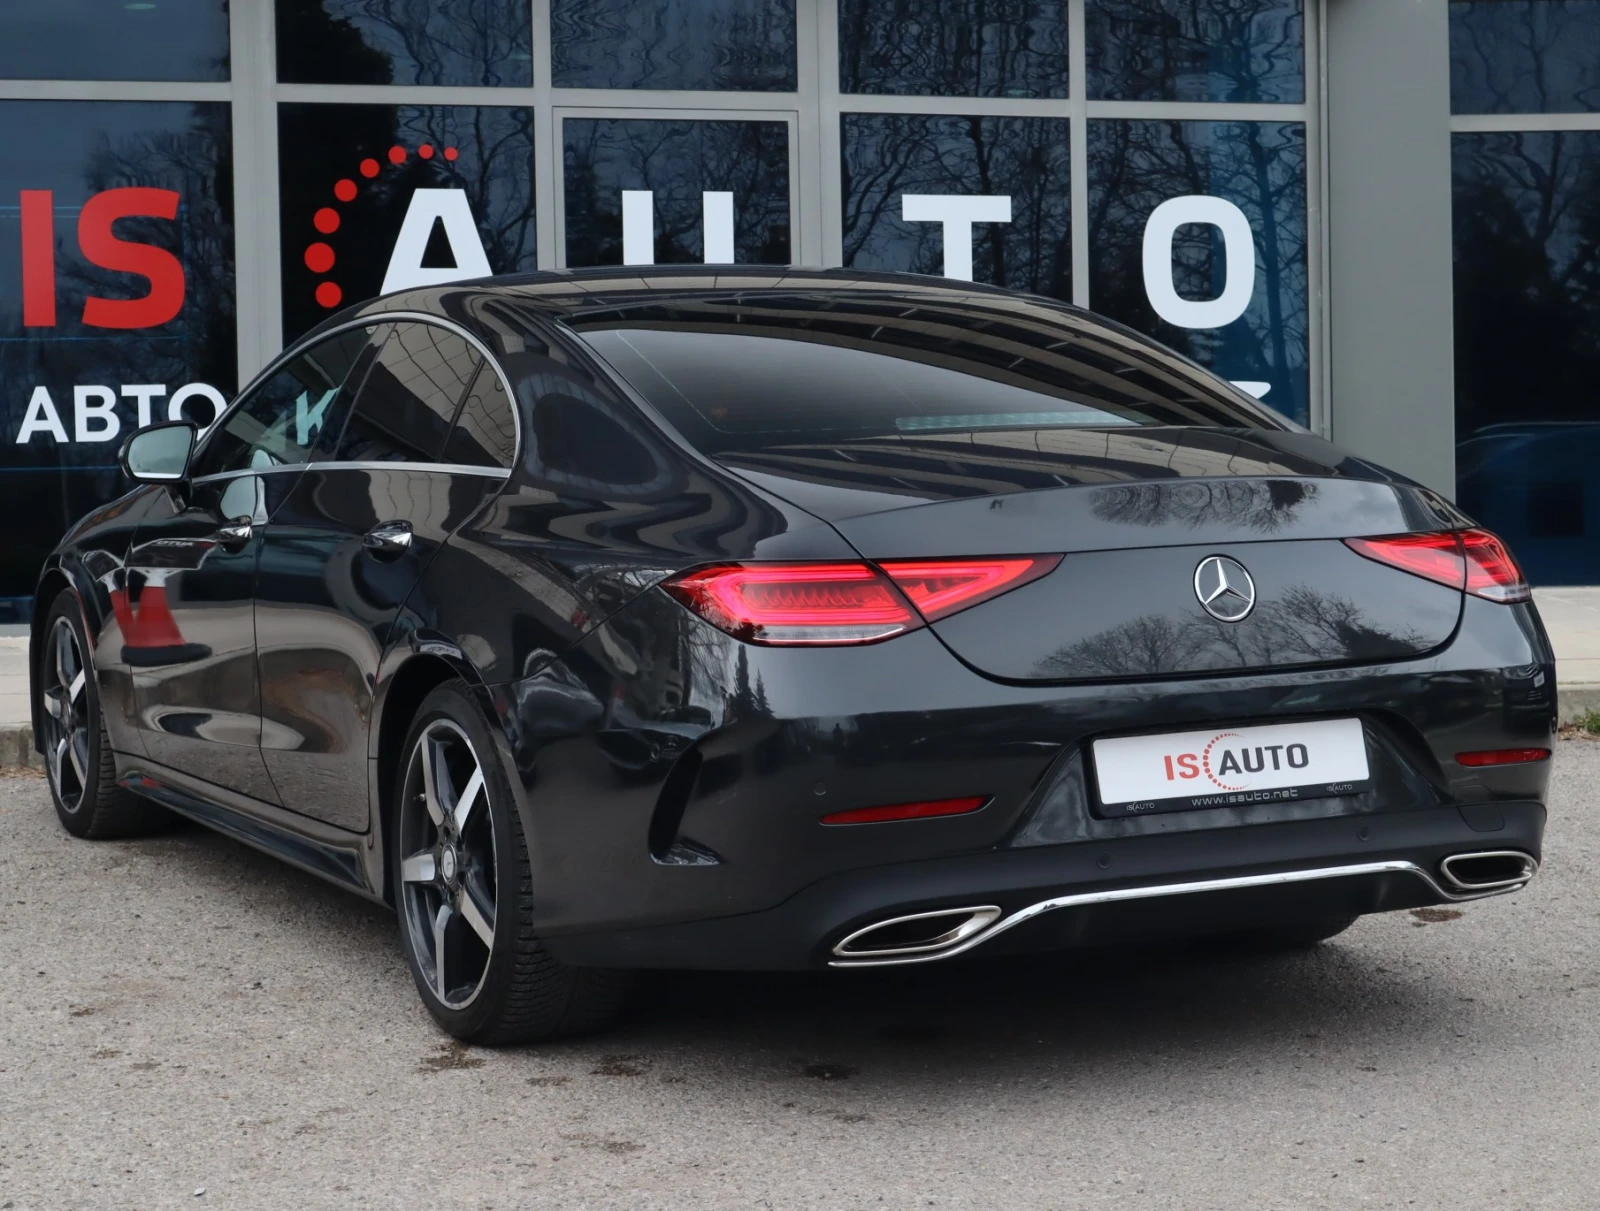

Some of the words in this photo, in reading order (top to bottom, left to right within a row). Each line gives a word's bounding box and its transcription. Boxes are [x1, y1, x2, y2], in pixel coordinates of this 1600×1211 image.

[21, 187, 186, 328] IS
[1164, 753, 1200, 781] IS
[1218, 743, 1309, 776] AUTO
[1191, 788, 1299, 806] www.isauto.net
